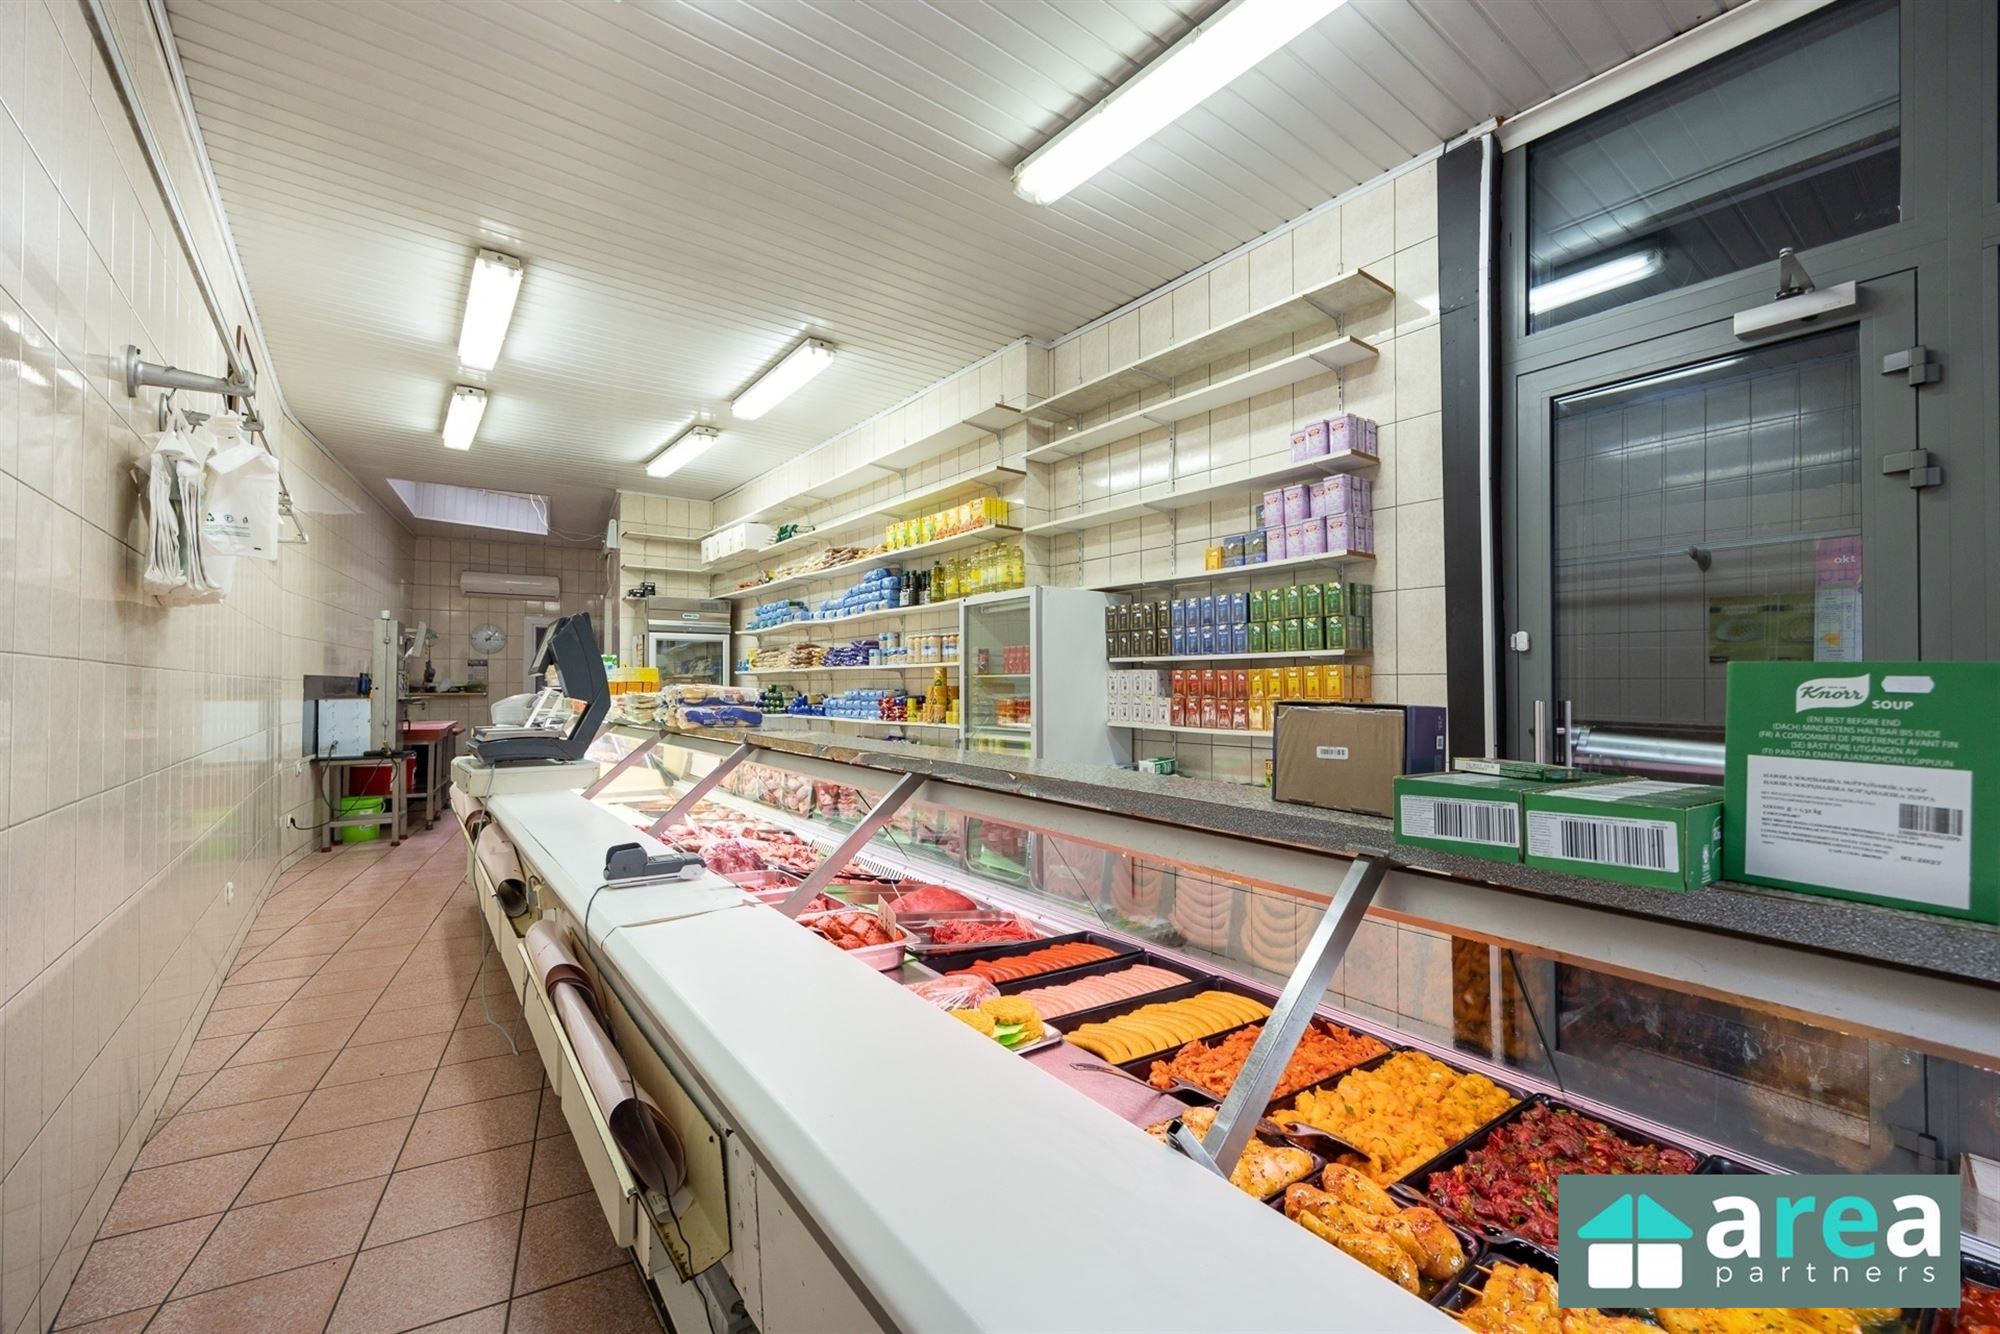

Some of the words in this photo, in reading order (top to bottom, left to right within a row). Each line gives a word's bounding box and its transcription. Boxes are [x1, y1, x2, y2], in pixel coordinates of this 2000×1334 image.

[1800, 685, 1863, 700] Knorr
[1872, 700, 1914, 710] SOUP
[1807, 716, 1823, 724] (EN)
[1825, 716, 1844, 724] BEST
[1847, 717, 1878, 726] BEFORE
[1881, 718, 1901, 726] END
[1773, 723, 1800, 731] (DACH)
[1802, 724, 1855, 734] MINDESTENS
[1857, 727, 1898, 736] HALTBAR
[1900, 729, 1913, 737] BIS
[1916, 730, 1941, 738] ENDE
[1782, 732, 1836, 740] CONSOMMER
[1838, 734, 1848, 742] DE
[1908, 738, 1940, 748] AVANT
[1942, 740, 1959, 749] FIN
[1791, 740, 1805, 748] (SE)
[1905, 748, 1919, 756] AV
[1775, 749, 1811, 758] PARASTA
[1812, 751, 1841, 760] ENNEN
[1843, 752, 1905, 764] AJANKOHDAN
[1907, 758, 1954, 768] LOPPUUN
[1813, 808, 1822, 816] kg
